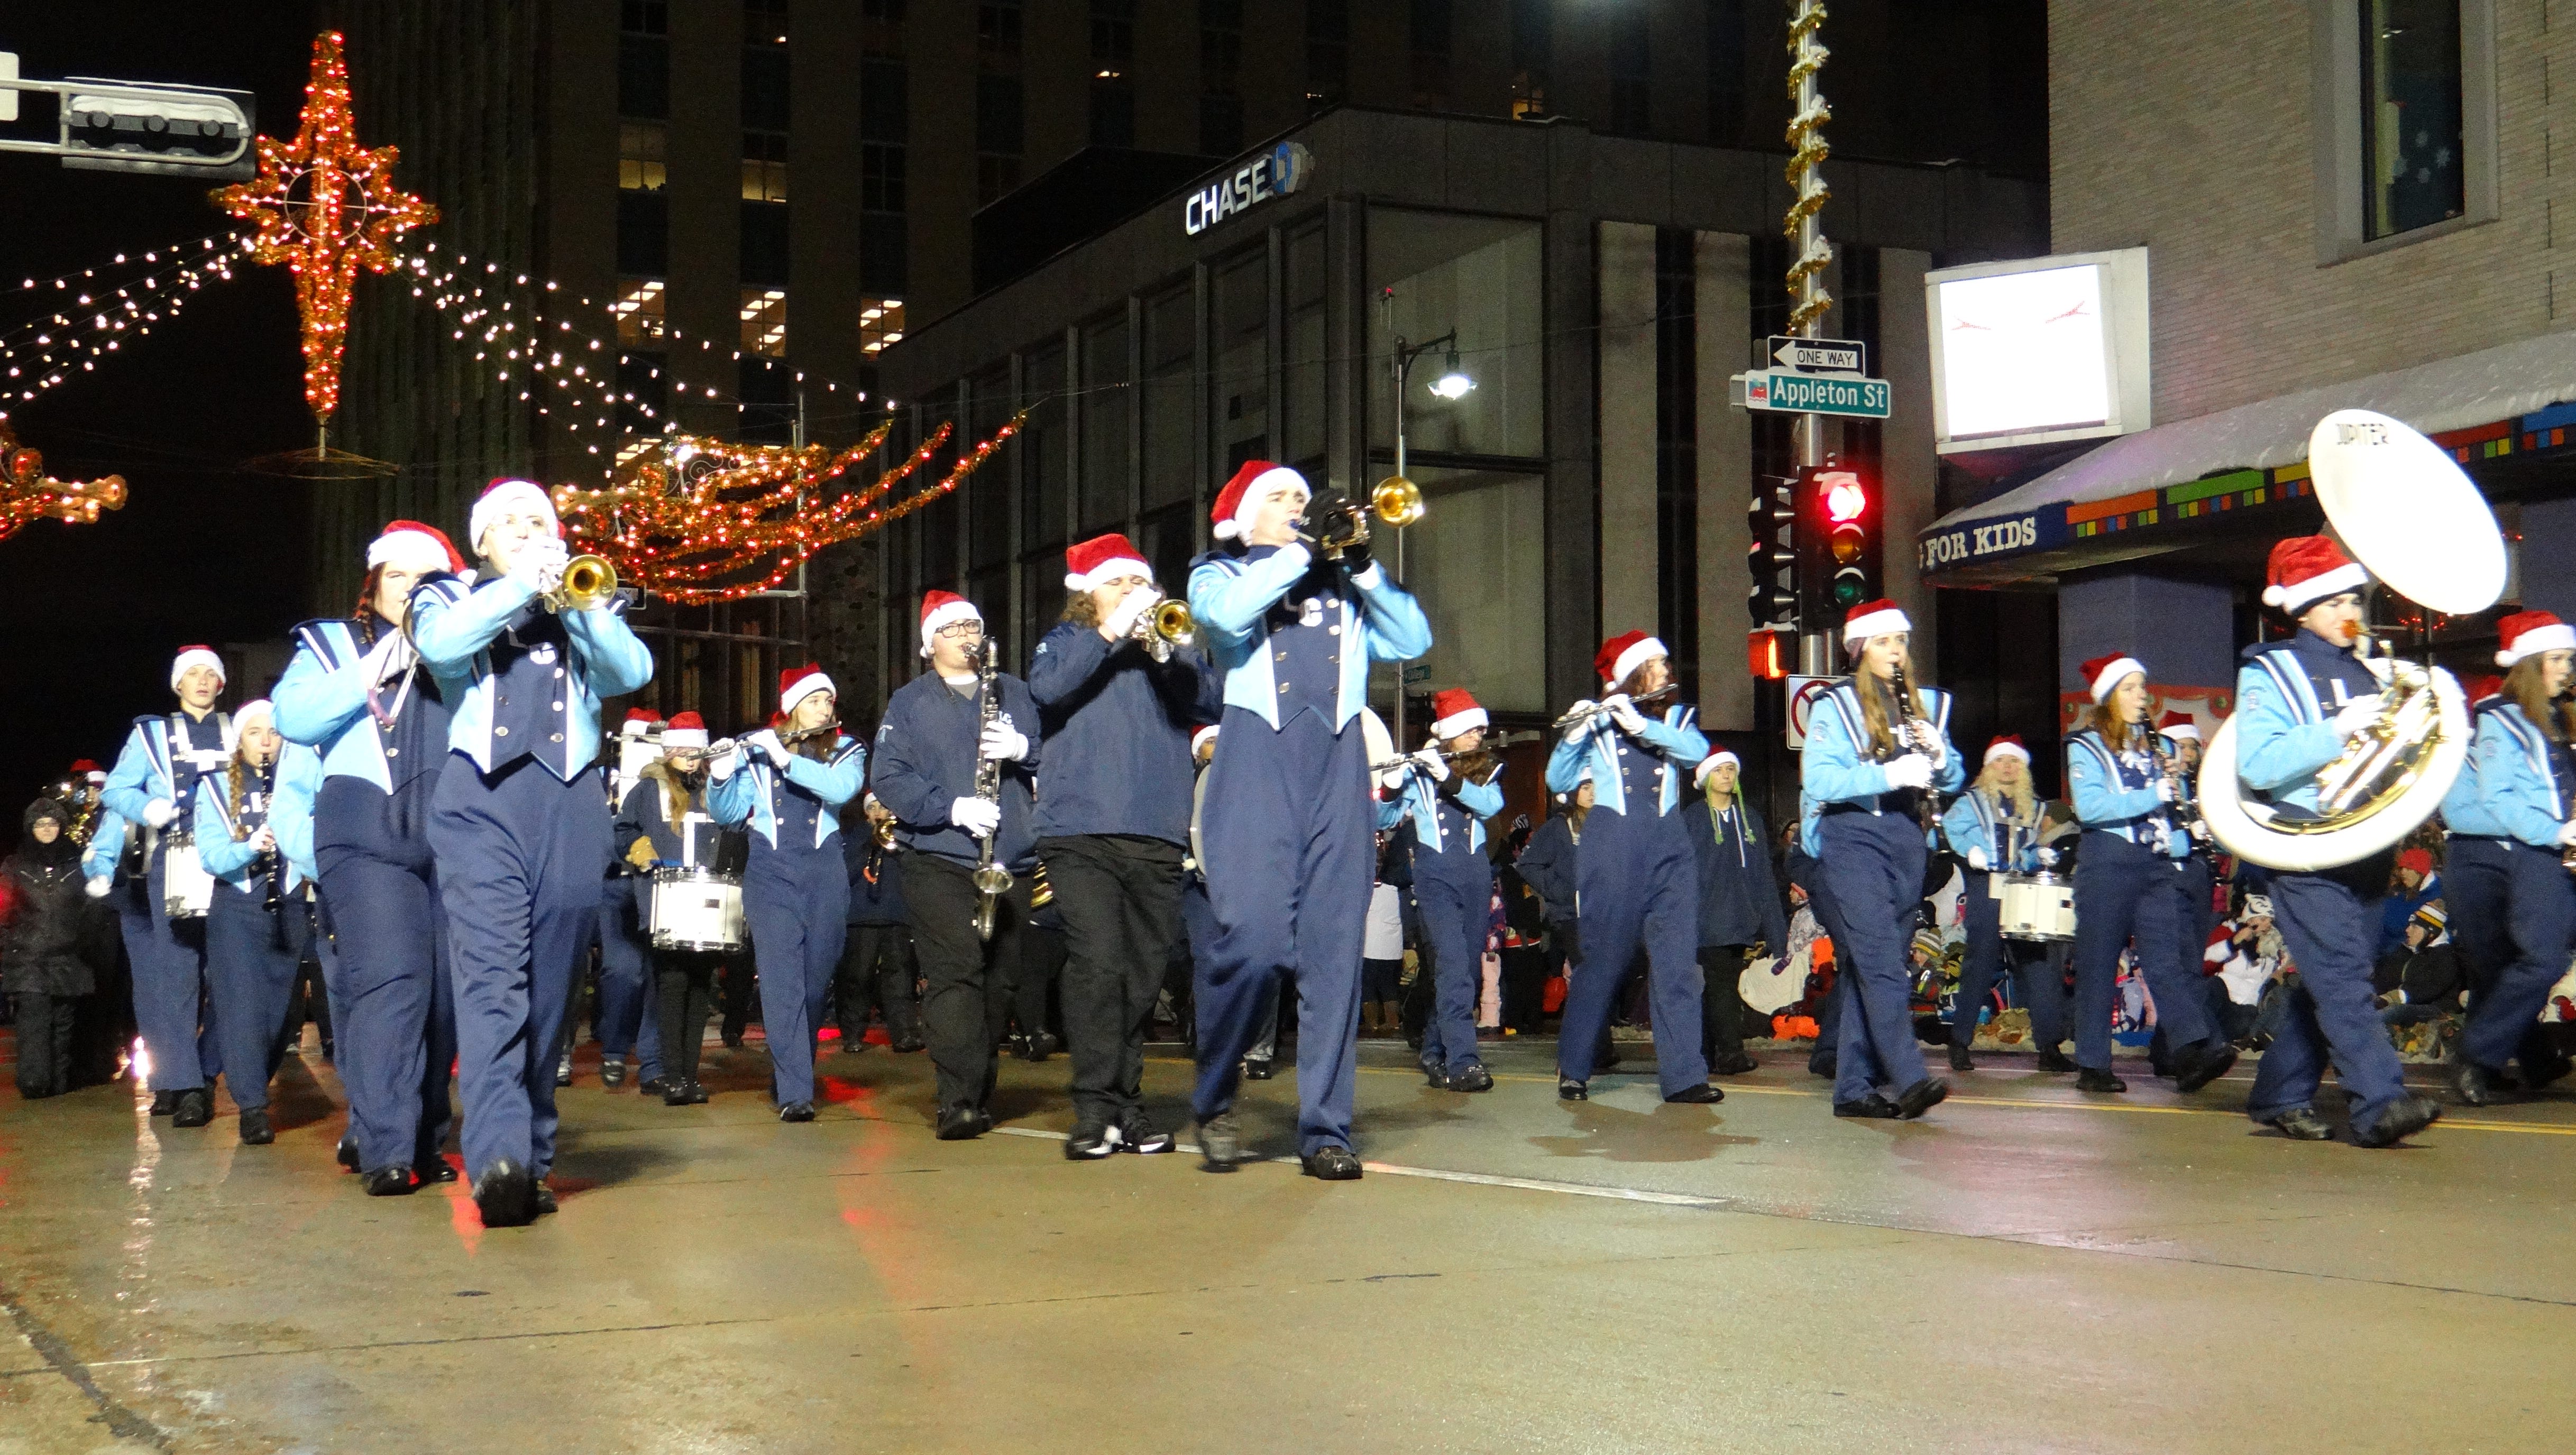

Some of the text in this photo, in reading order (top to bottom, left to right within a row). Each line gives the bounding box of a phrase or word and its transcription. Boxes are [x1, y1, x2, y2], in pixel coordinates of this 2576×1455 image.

[1186, 159, 1267, 235] CHASE
[1797, 349, 1853, 366] ONE WAY
[1774, 377, 1885, 409] Appleton St
[1926, 531, 1968, 566] FOR
[1973, 516, 2037, 555] KIDS
